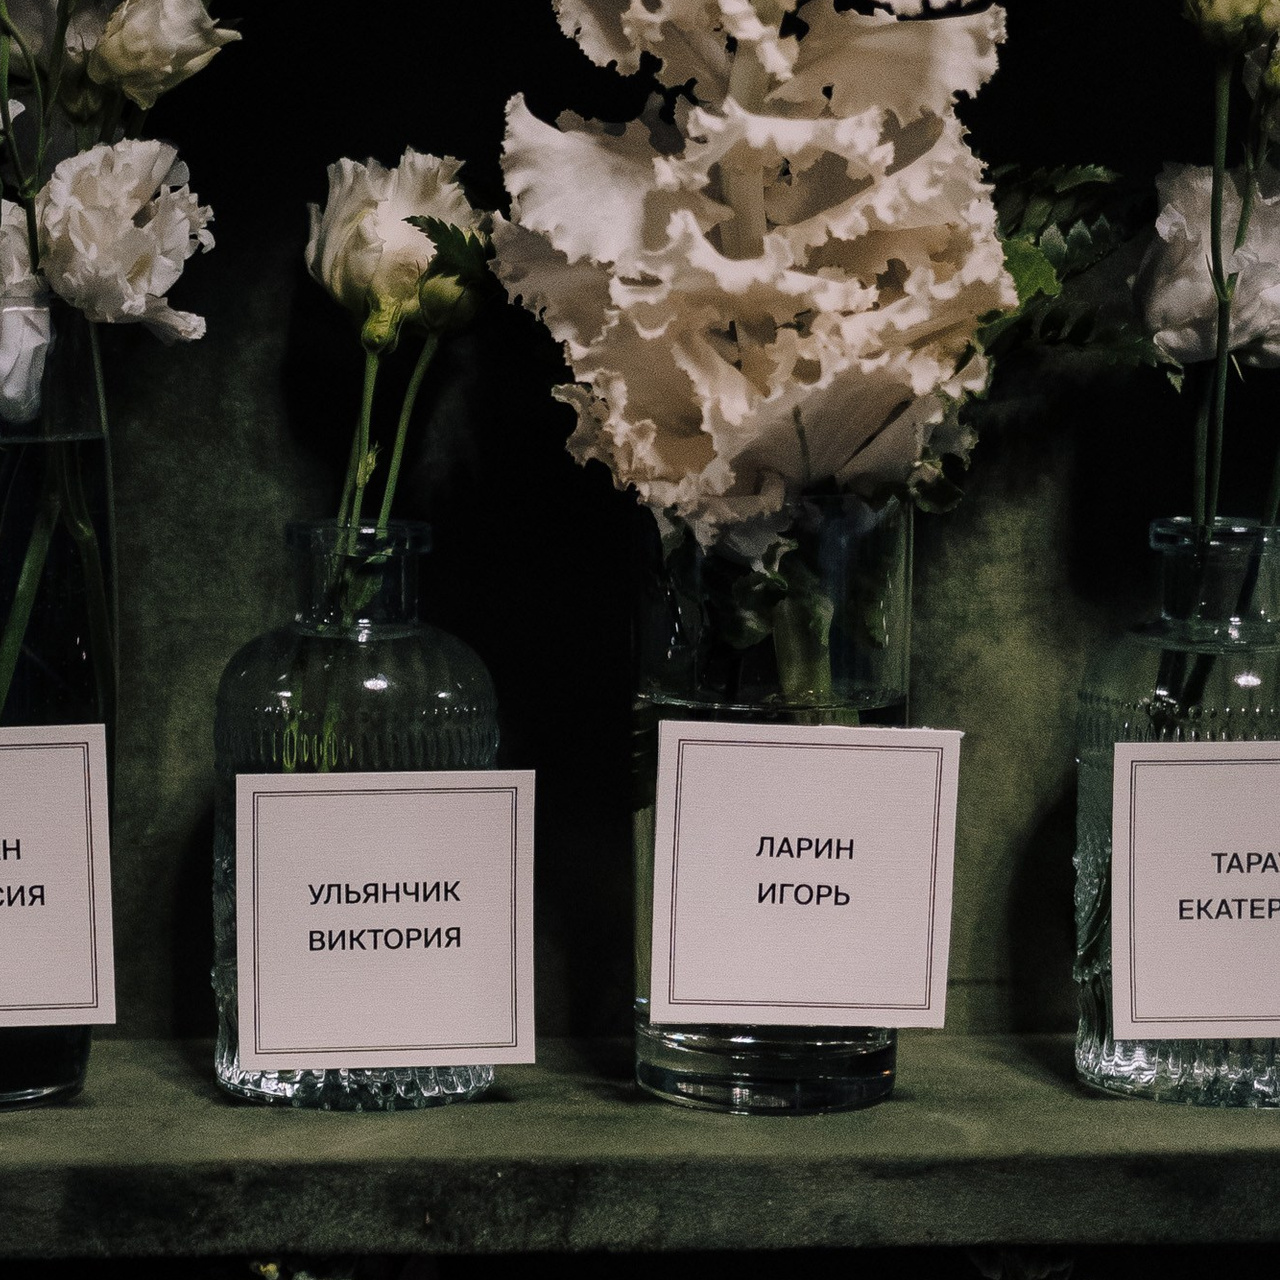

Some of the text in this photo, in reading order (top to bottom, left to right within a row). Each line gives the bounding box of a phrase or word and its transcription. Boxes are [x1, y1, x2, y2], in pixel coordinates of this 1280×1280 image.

[755, 836, 854, 860] ЛАРИН
[1210, 852, 1280, 874] ТАРА
[307, 880, 461, 906] УЛЬЯНЧИК
[757, 882, 851, 906] ИГОРЬ
[1178, 898, 1280, 920] ЕКАТЕР
[308, 926, 461, 952] ВИКТОРИЯ
